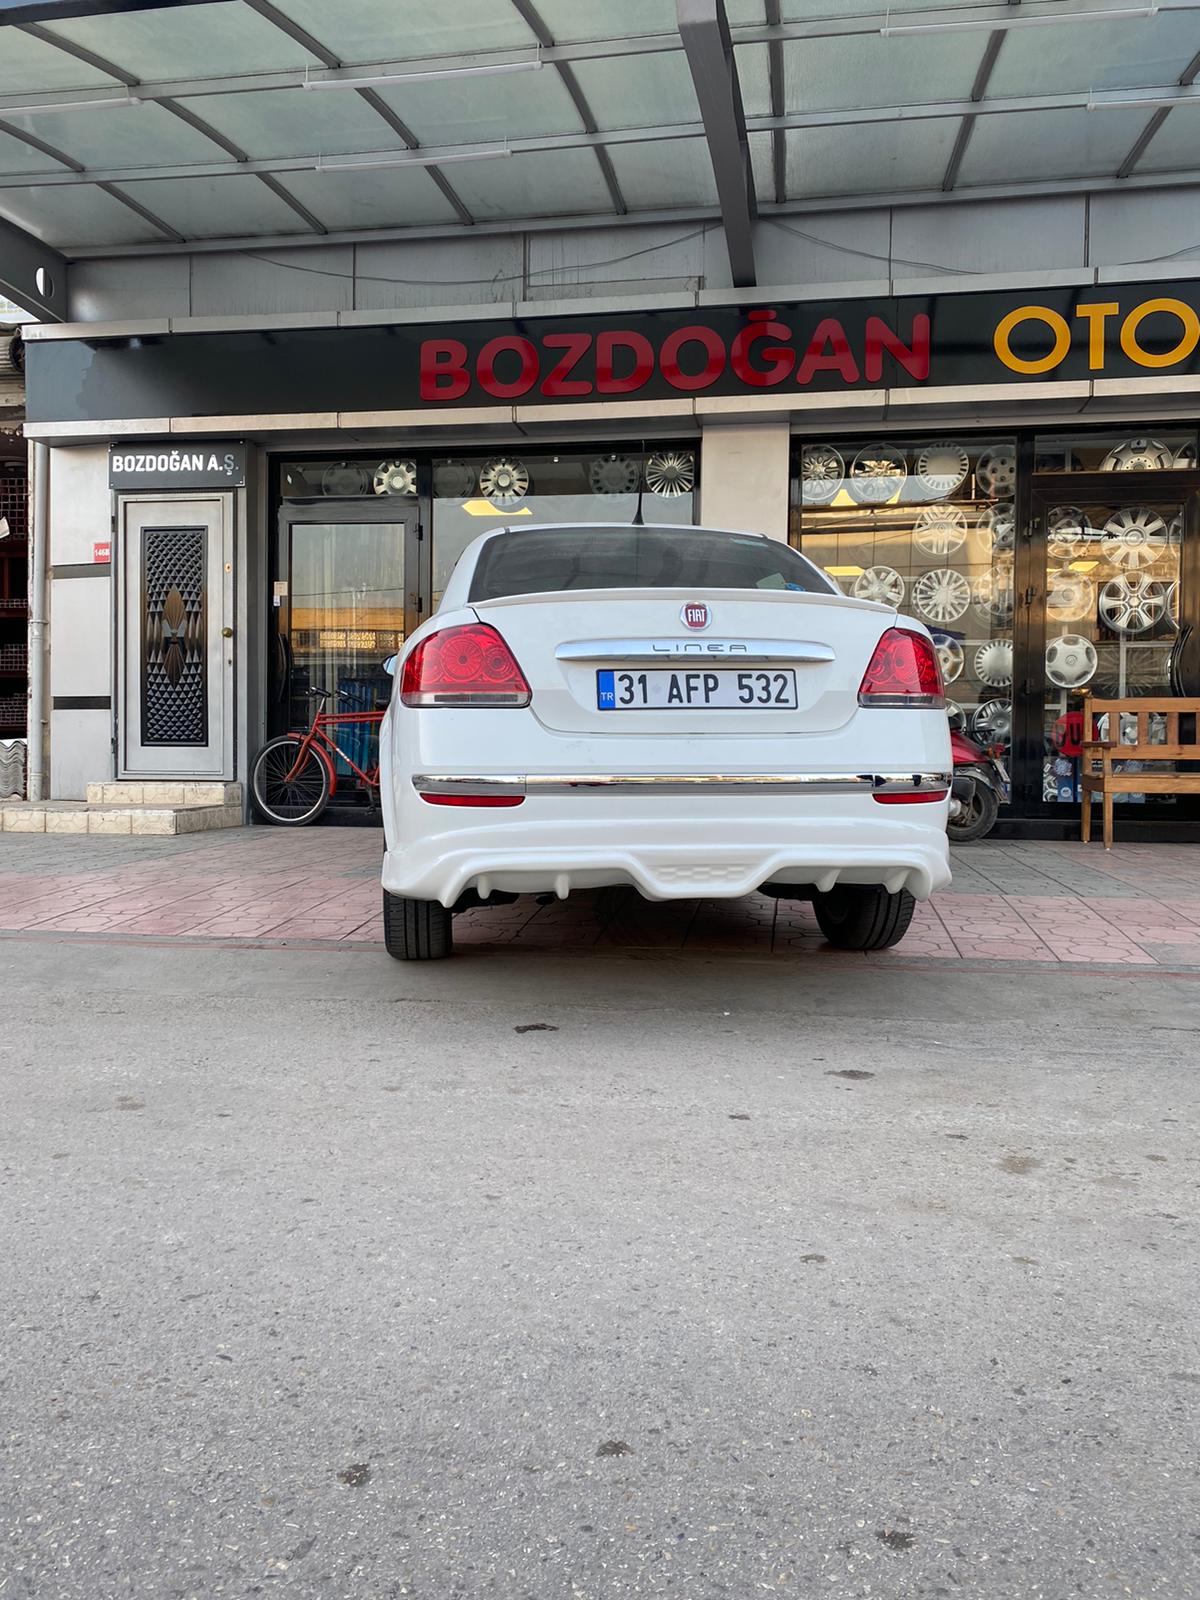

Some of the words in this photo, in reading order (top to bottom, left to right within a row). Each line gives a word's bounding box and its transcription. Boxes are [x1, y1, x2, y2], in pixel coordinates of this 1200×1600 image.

[420, 310, 931, 401] BOZDOĞAN
[993, 298, 1200, 374] OTO
[112, 450, 204, 472] BOZDOĞAN
[687, 609, 705, 623] FIAT
[601, 691, 614, 701] TR
[618, 674, 648, 704] 31
[667, 674, 719, 704] AFP
[737, 674, 790, 704] 532
